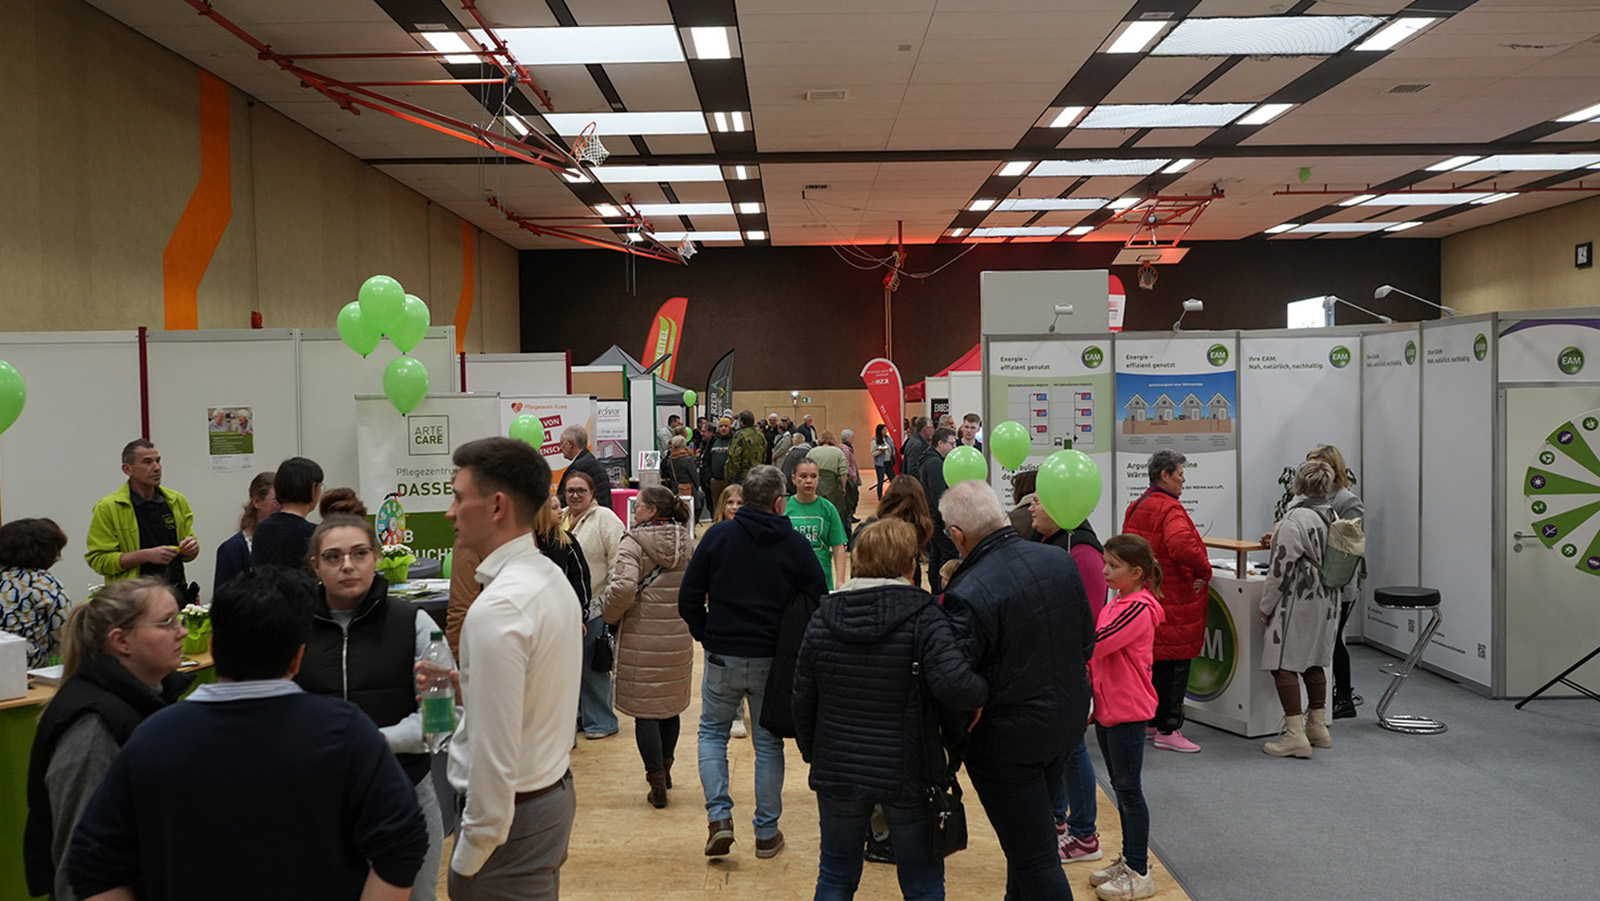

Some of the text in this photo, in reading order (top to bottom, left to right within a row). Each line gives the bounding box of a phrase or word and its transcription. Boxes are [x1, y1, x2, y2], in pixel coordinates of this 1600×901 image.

[1561, 356, 1582, 365] EAM
[543, 418, 560, 427] VON
[415, 426, 443, 436] ARTE
[415, 435, 443, 445] CARE
[396, 467, 453, 478] Pflegezentru
[397, 482, 453, 497] DASSE
[793, 525, 818, 533] ARTE
